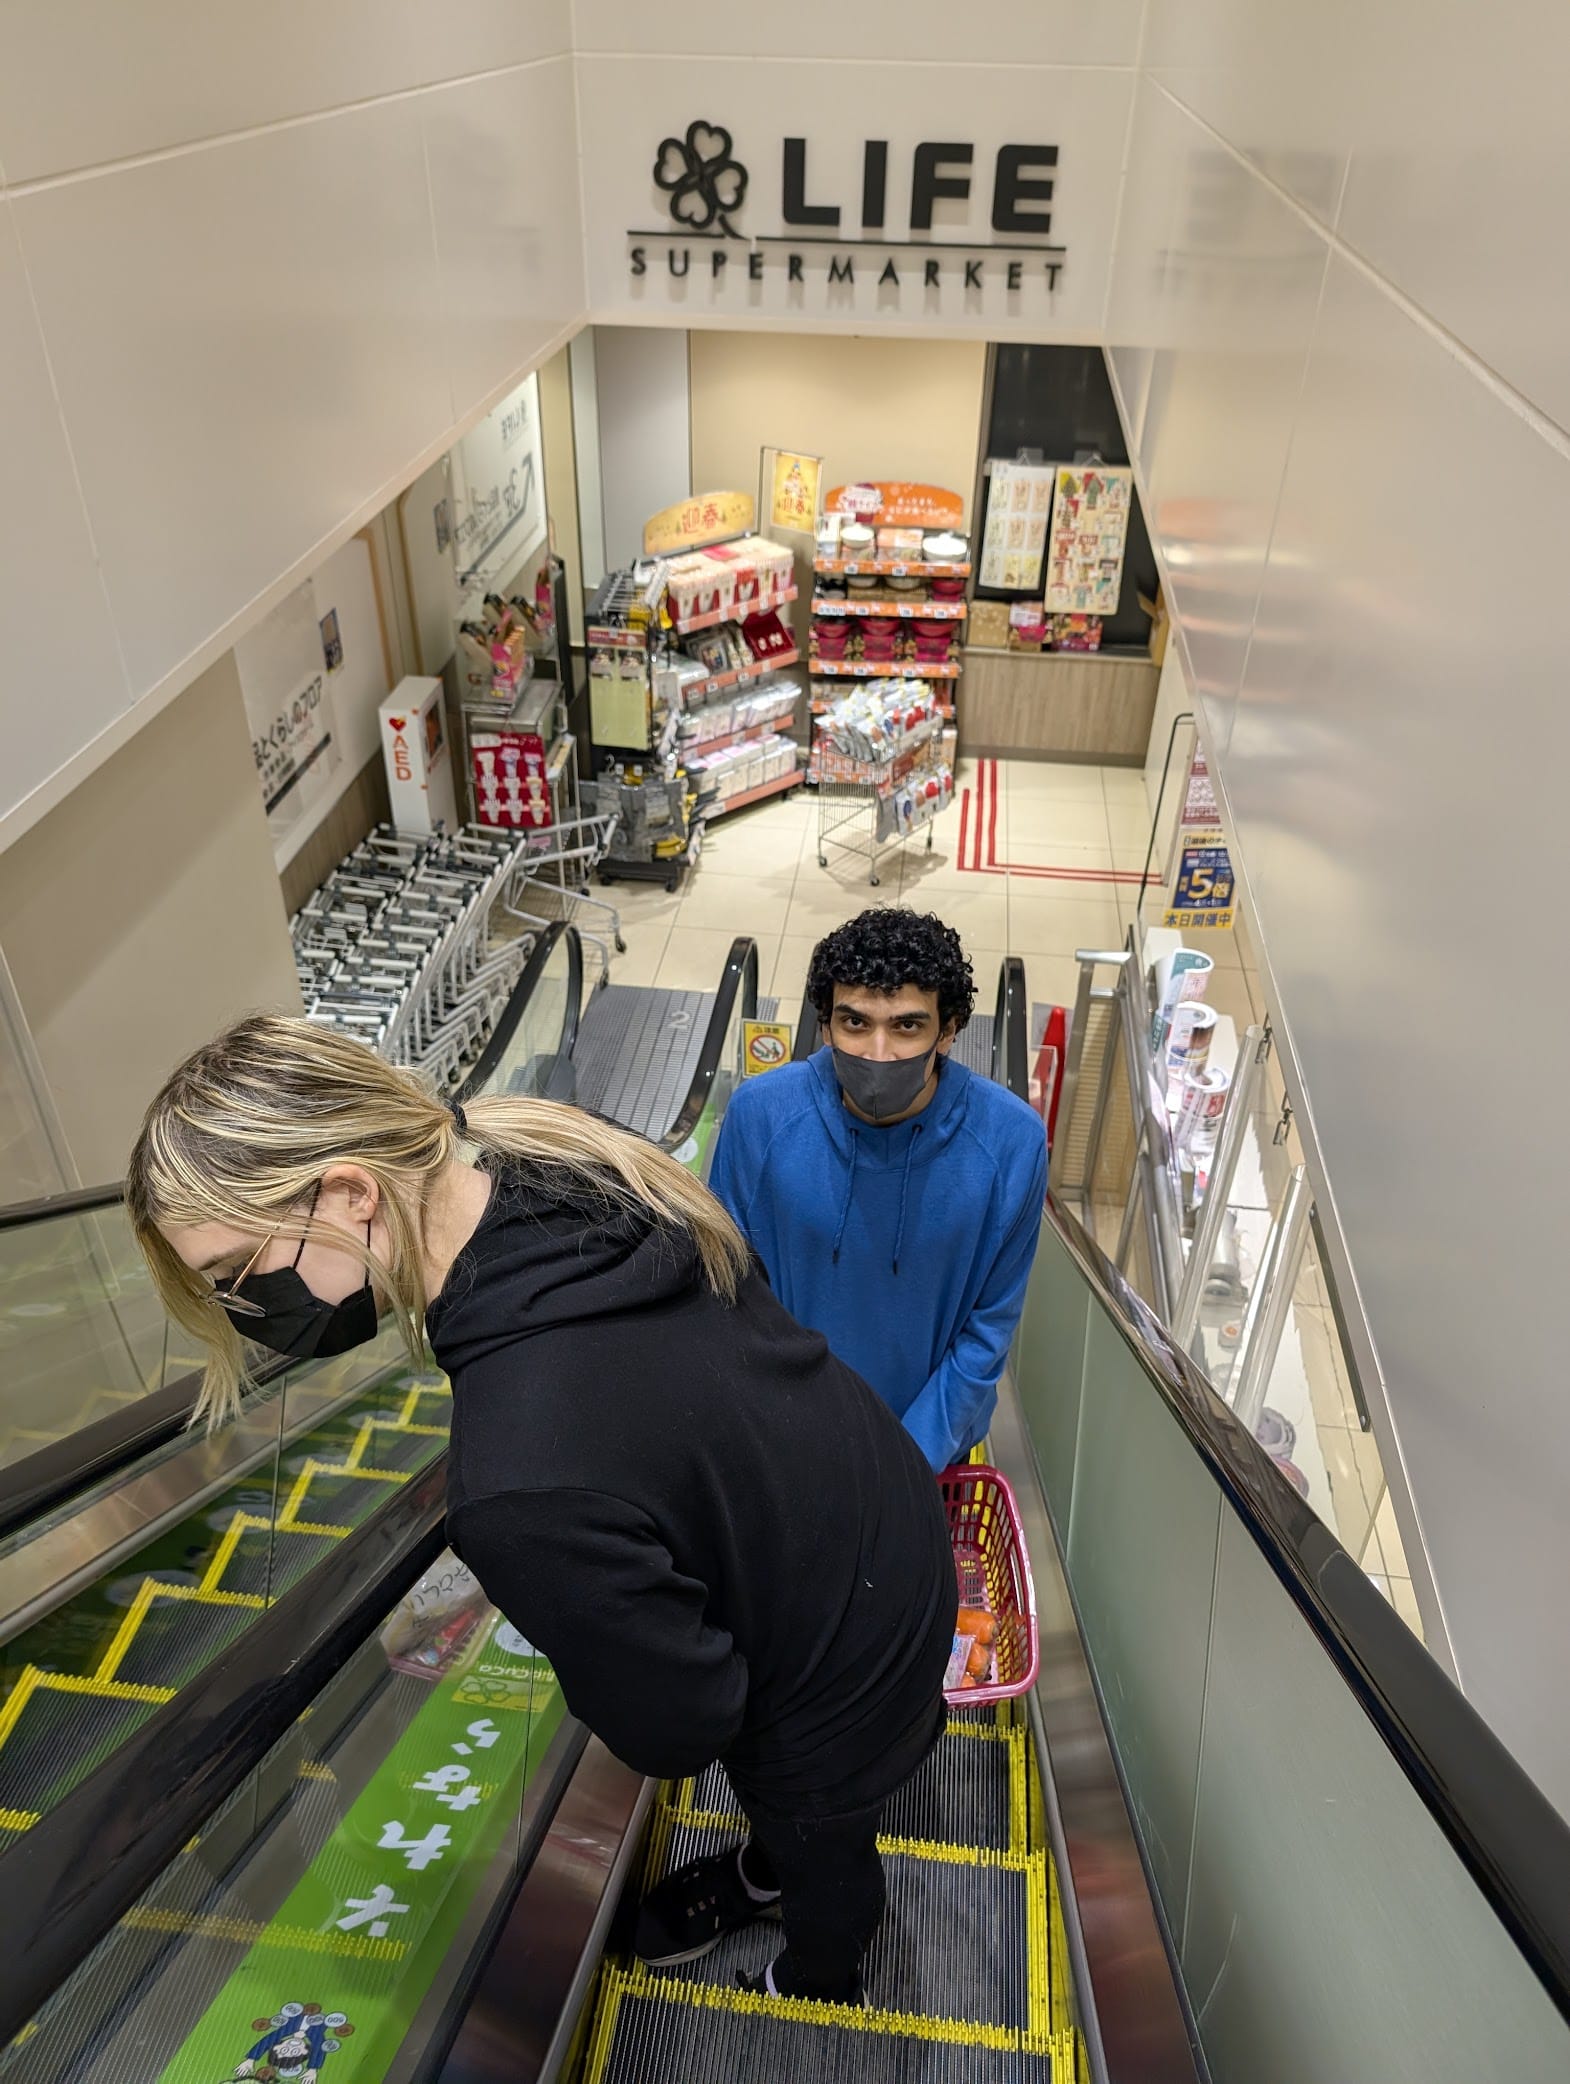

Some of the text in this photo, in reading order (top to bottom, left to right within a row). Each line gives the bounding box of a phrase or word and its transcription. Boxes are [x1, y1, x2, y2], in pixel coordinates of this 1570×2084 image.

[782, 137, 1060, 234] LIFE
[630, 248, 1063, 292] SUPERMARKET
[682, 503, 718, 534] 迎春
[393, 734, 412, 781] AED
[335, 1718, 501, 1937] それなら
